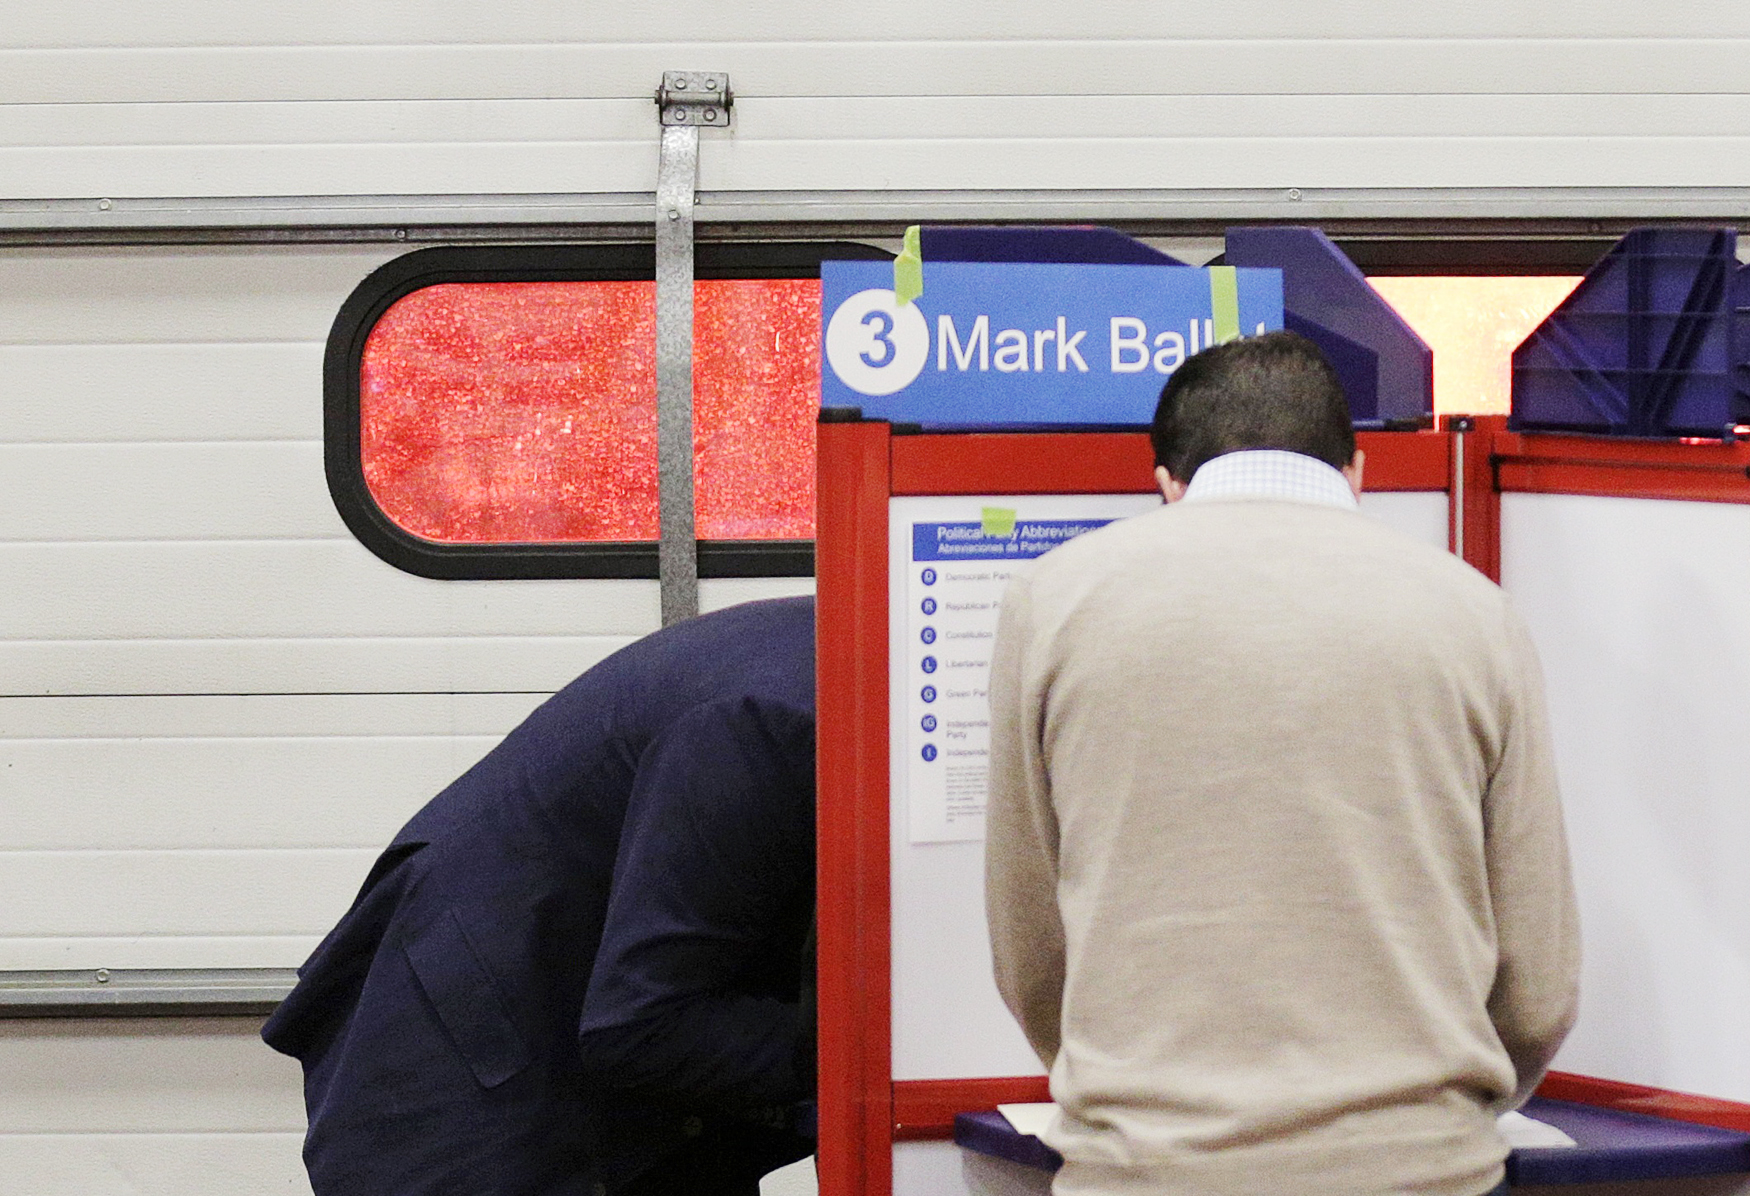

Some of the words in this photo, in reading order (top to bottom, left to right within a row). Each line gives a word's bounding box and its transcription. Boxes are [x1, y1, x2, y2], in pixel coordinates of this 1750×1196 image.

[859, 310, 897, 369] 3
[937, 314, 1090, 373] Mark
[1109, 315, 1266, 374] Ball
[938, 526, 983, 540] Political
[1006, 543, 1018, 552] de
